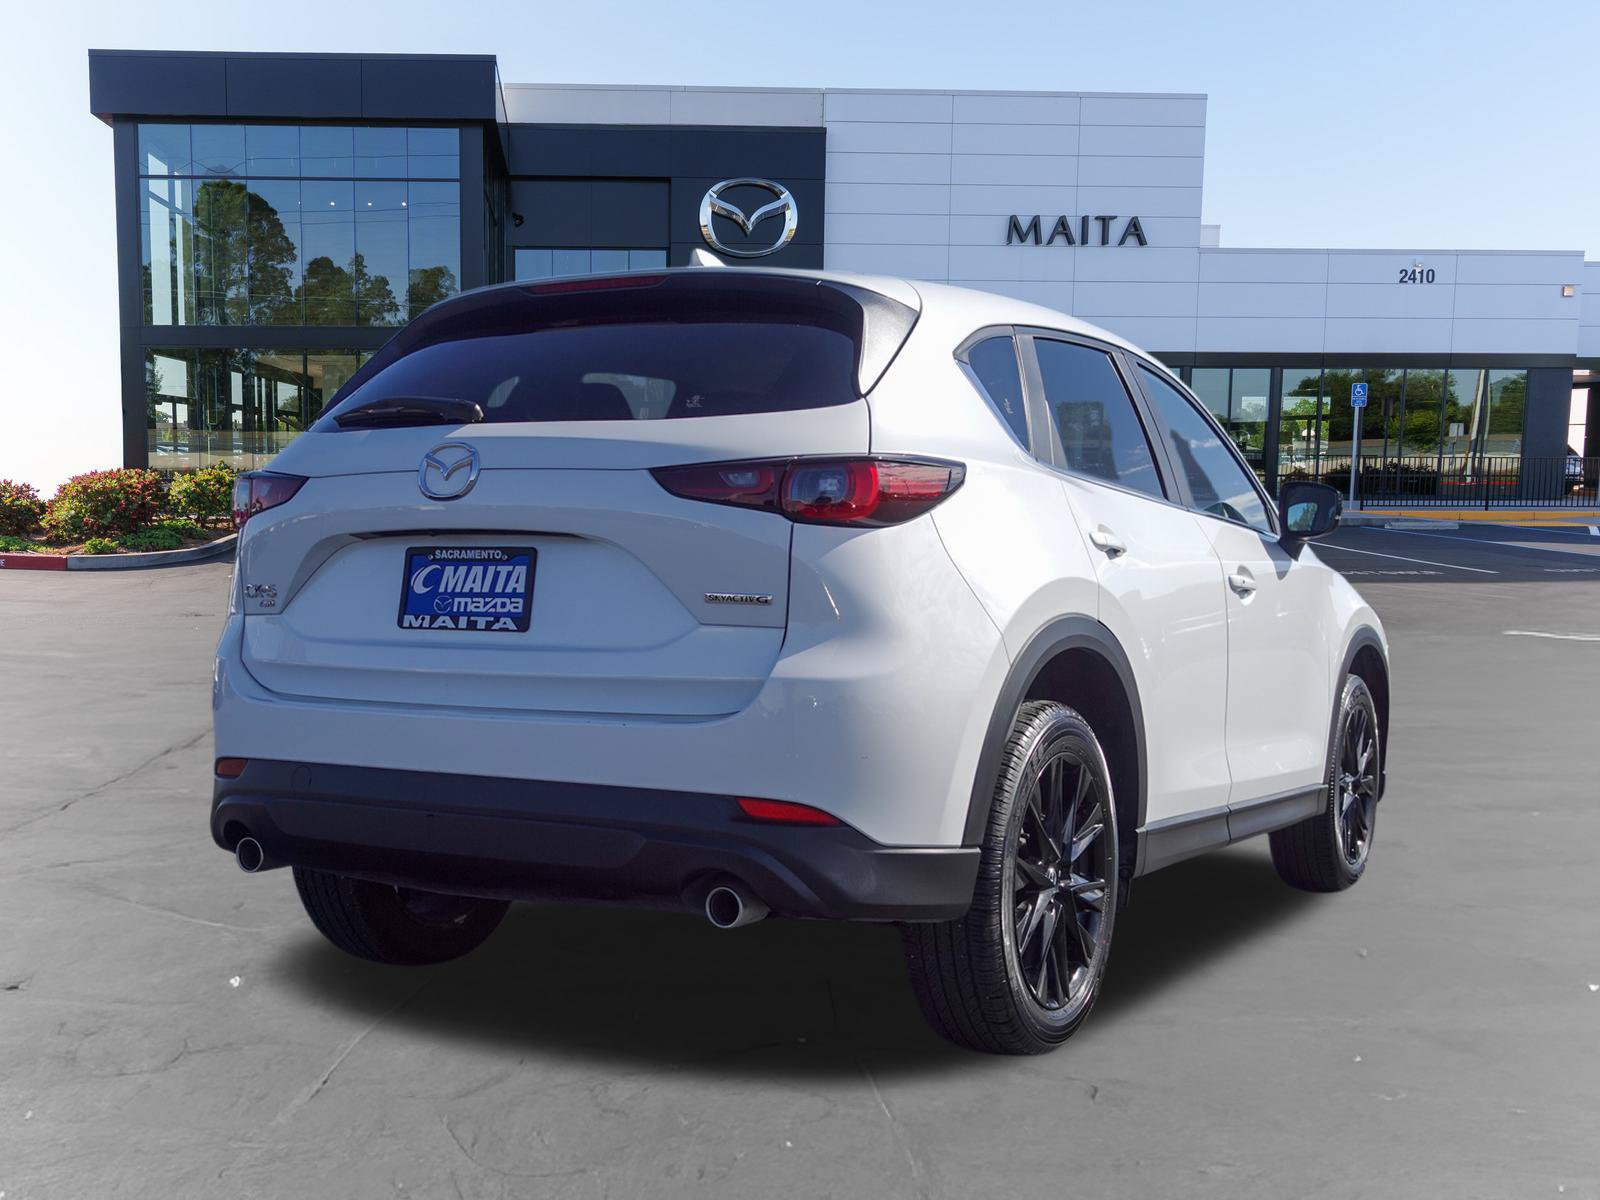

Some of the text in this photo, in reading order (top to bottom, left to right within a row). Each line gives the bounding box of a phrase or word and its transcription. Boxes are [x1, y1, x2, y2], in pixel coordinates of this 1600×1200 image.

[1006, 214, 1148, 246] MAITA
[1399, 269, 1435, 284] 2410
[434, 550, 502, 559] SACRAMENTO
[438, 565, 527, 593] MAITA
[402, 615, 517, 630] MAITA
